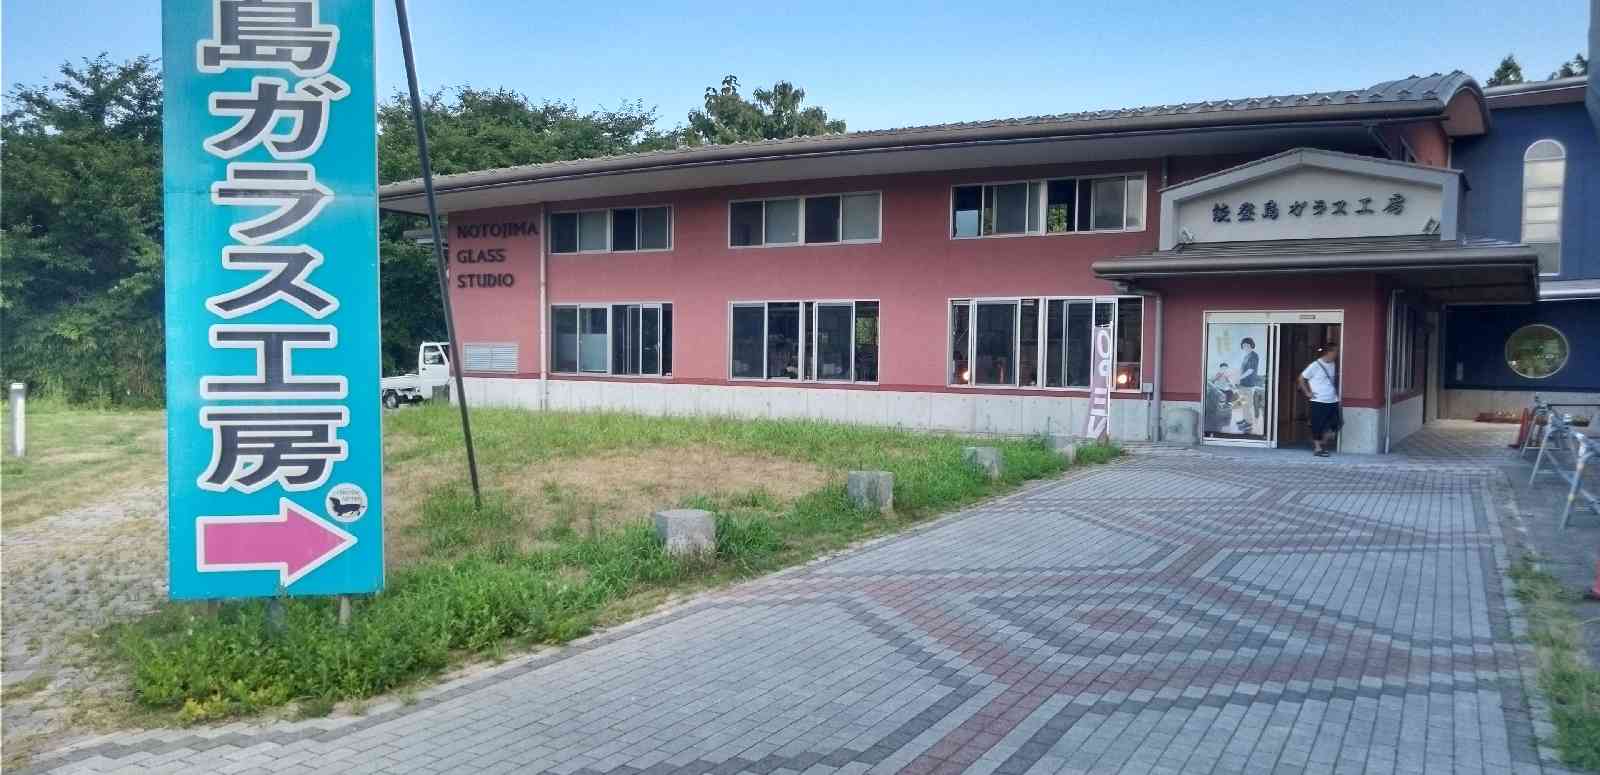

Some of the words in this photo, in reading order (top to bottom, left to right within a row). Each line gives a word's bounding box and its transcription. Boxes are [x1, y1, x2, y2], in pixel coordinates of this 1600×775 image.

[1211, 193, 1406, 223] 能登島ガラス工房
[457, 222, 539, 239] NOTOJIMA
[198, 0, 350, 493] 島ガラス工房
[457, 248, 507, 264] GLASS
[457, 273, 515, 289] STUDIO
